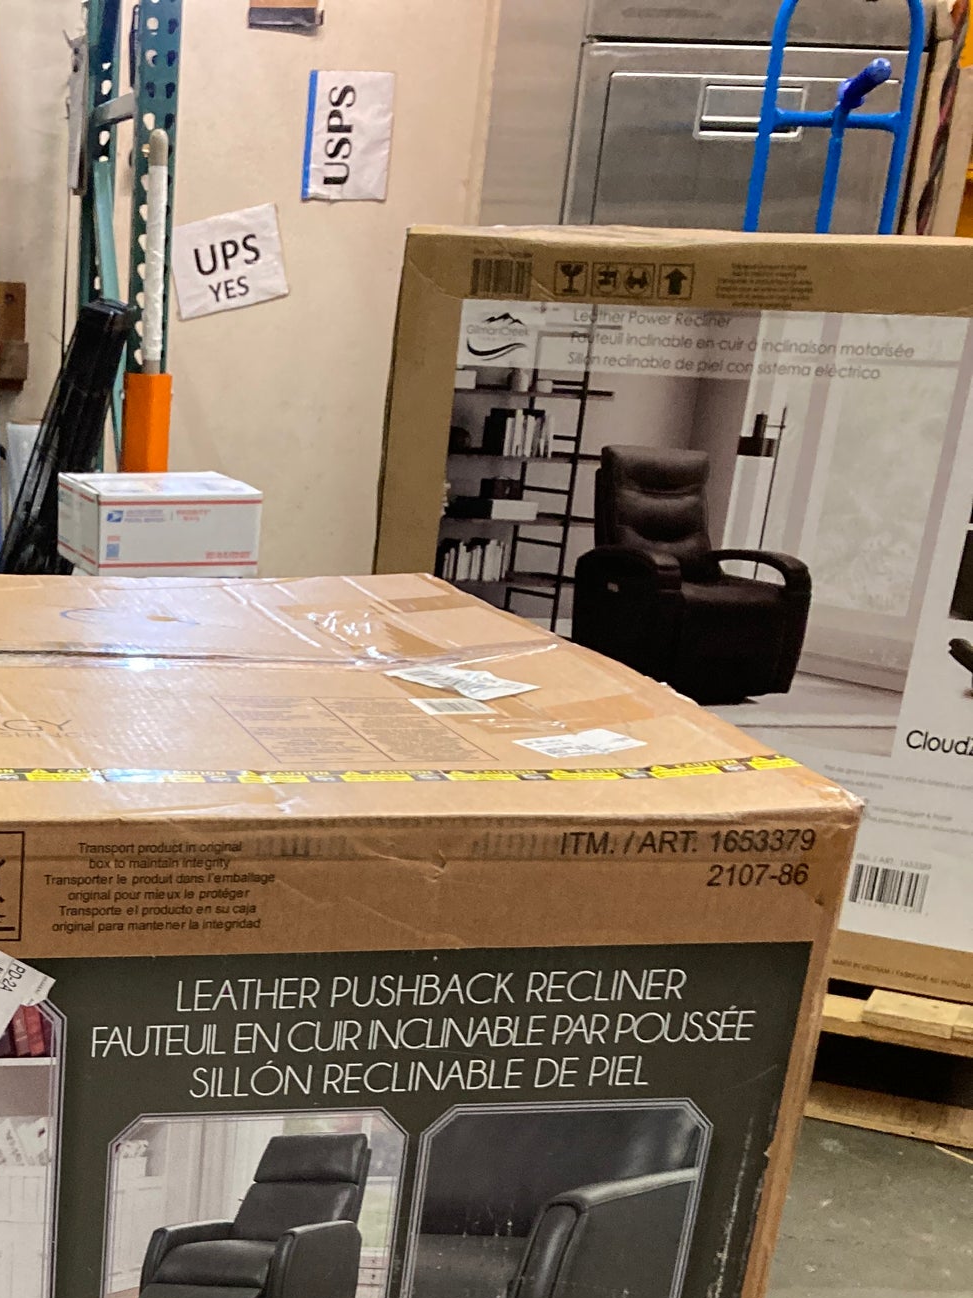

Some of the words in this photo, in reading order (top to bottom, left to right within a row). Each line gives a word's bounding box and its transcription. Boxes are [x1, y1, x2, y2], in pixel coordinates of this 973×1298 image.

[323, 85, 356, 185] USPS
[193, 233, 261, 276] UPS
[209, 275, 250, 303] YES
[573, 309, 625, 324] Leather
[628, 309, 671, 326] Power
[675, 310, 731, 328] Recliner
[627, 332, 693, 350] inclinable
[762, 339, 836, 355] inclinaison
[840, 342, 915, 358] motorisée
[603, 354, 670, 370] reclinable
[675, 356, 693, 370] de
[697, 359, 724, 374] piel
[727, 363, 754, 375] con
[757, 362, 811, 377] sistema
[77, 842, 135, 855] Transport
[137, 842, 183, 855] product
[185, 842, 196, 853] in
[199, 841, 243, 855] original
[560, 831, 614, 855] ITM.
[637, 830, 698, 854] ART.
[710, 828, 817, 853] 1653379
[88, 857, 110, 869] box
[114, 858, 126, 869] to
[128, 857, 179, 869] maintain
[182, 857, 231, 871] integrity
[706, 863, 810, 887] 2107-86
[44, 874, 114, 886] Transporter
[116, 874, 128, 884] le
[131, 873, 174, 886] produit
[176, 873, 204, 884] dans
[207, 872, 276, 885] l'emballage
[68, 888, 111, 903] original
[114, 891, 141, 902] pour
[143, 889, 181, 900] mieux
[183, 888, 196, 899] le
[199, 887, 251, 902] protéger
[58, 905, 121, 917] Transporte
[126, 904, 138, 915] el
[141, 904, 193, 917] producto
[195, 905, 212, 915] en
[214, 905, 230, 914] su
[232, 903, 257, 916] caja
[52, 920, 94, 934] original
[97, 922, 125, 933] para
[128, 920, 187, 931] mantener
[189, 919, 200, 930] la
[202, 918, 262, 931] integridad
[0, 963, 26, 993] PD-2A
[176, 977, 320, 1012] LEATHER
[329, 972, 515, 1008] PUSHBACK
[525, 968, 687, 1003] RECLINER
[91, 1023, 226, 1058] FAUTEUIL
[233, 1022, 281, 1055] EN
[287, 1019, 363, 1053] CUIR
[367, 1015, 547, 1051] INCLINABLE
[551, 1013, 610, 1045] PAR
[614, 1004, 757, 1044] POUSSÉE
[189, 1060, 313, 1098] SILLÓN
[323, 1058, 525, 1094] RECLINABLE
[534, 1056, 580, 1088] DE
[588, 1055, 649, 1087] PIEL
